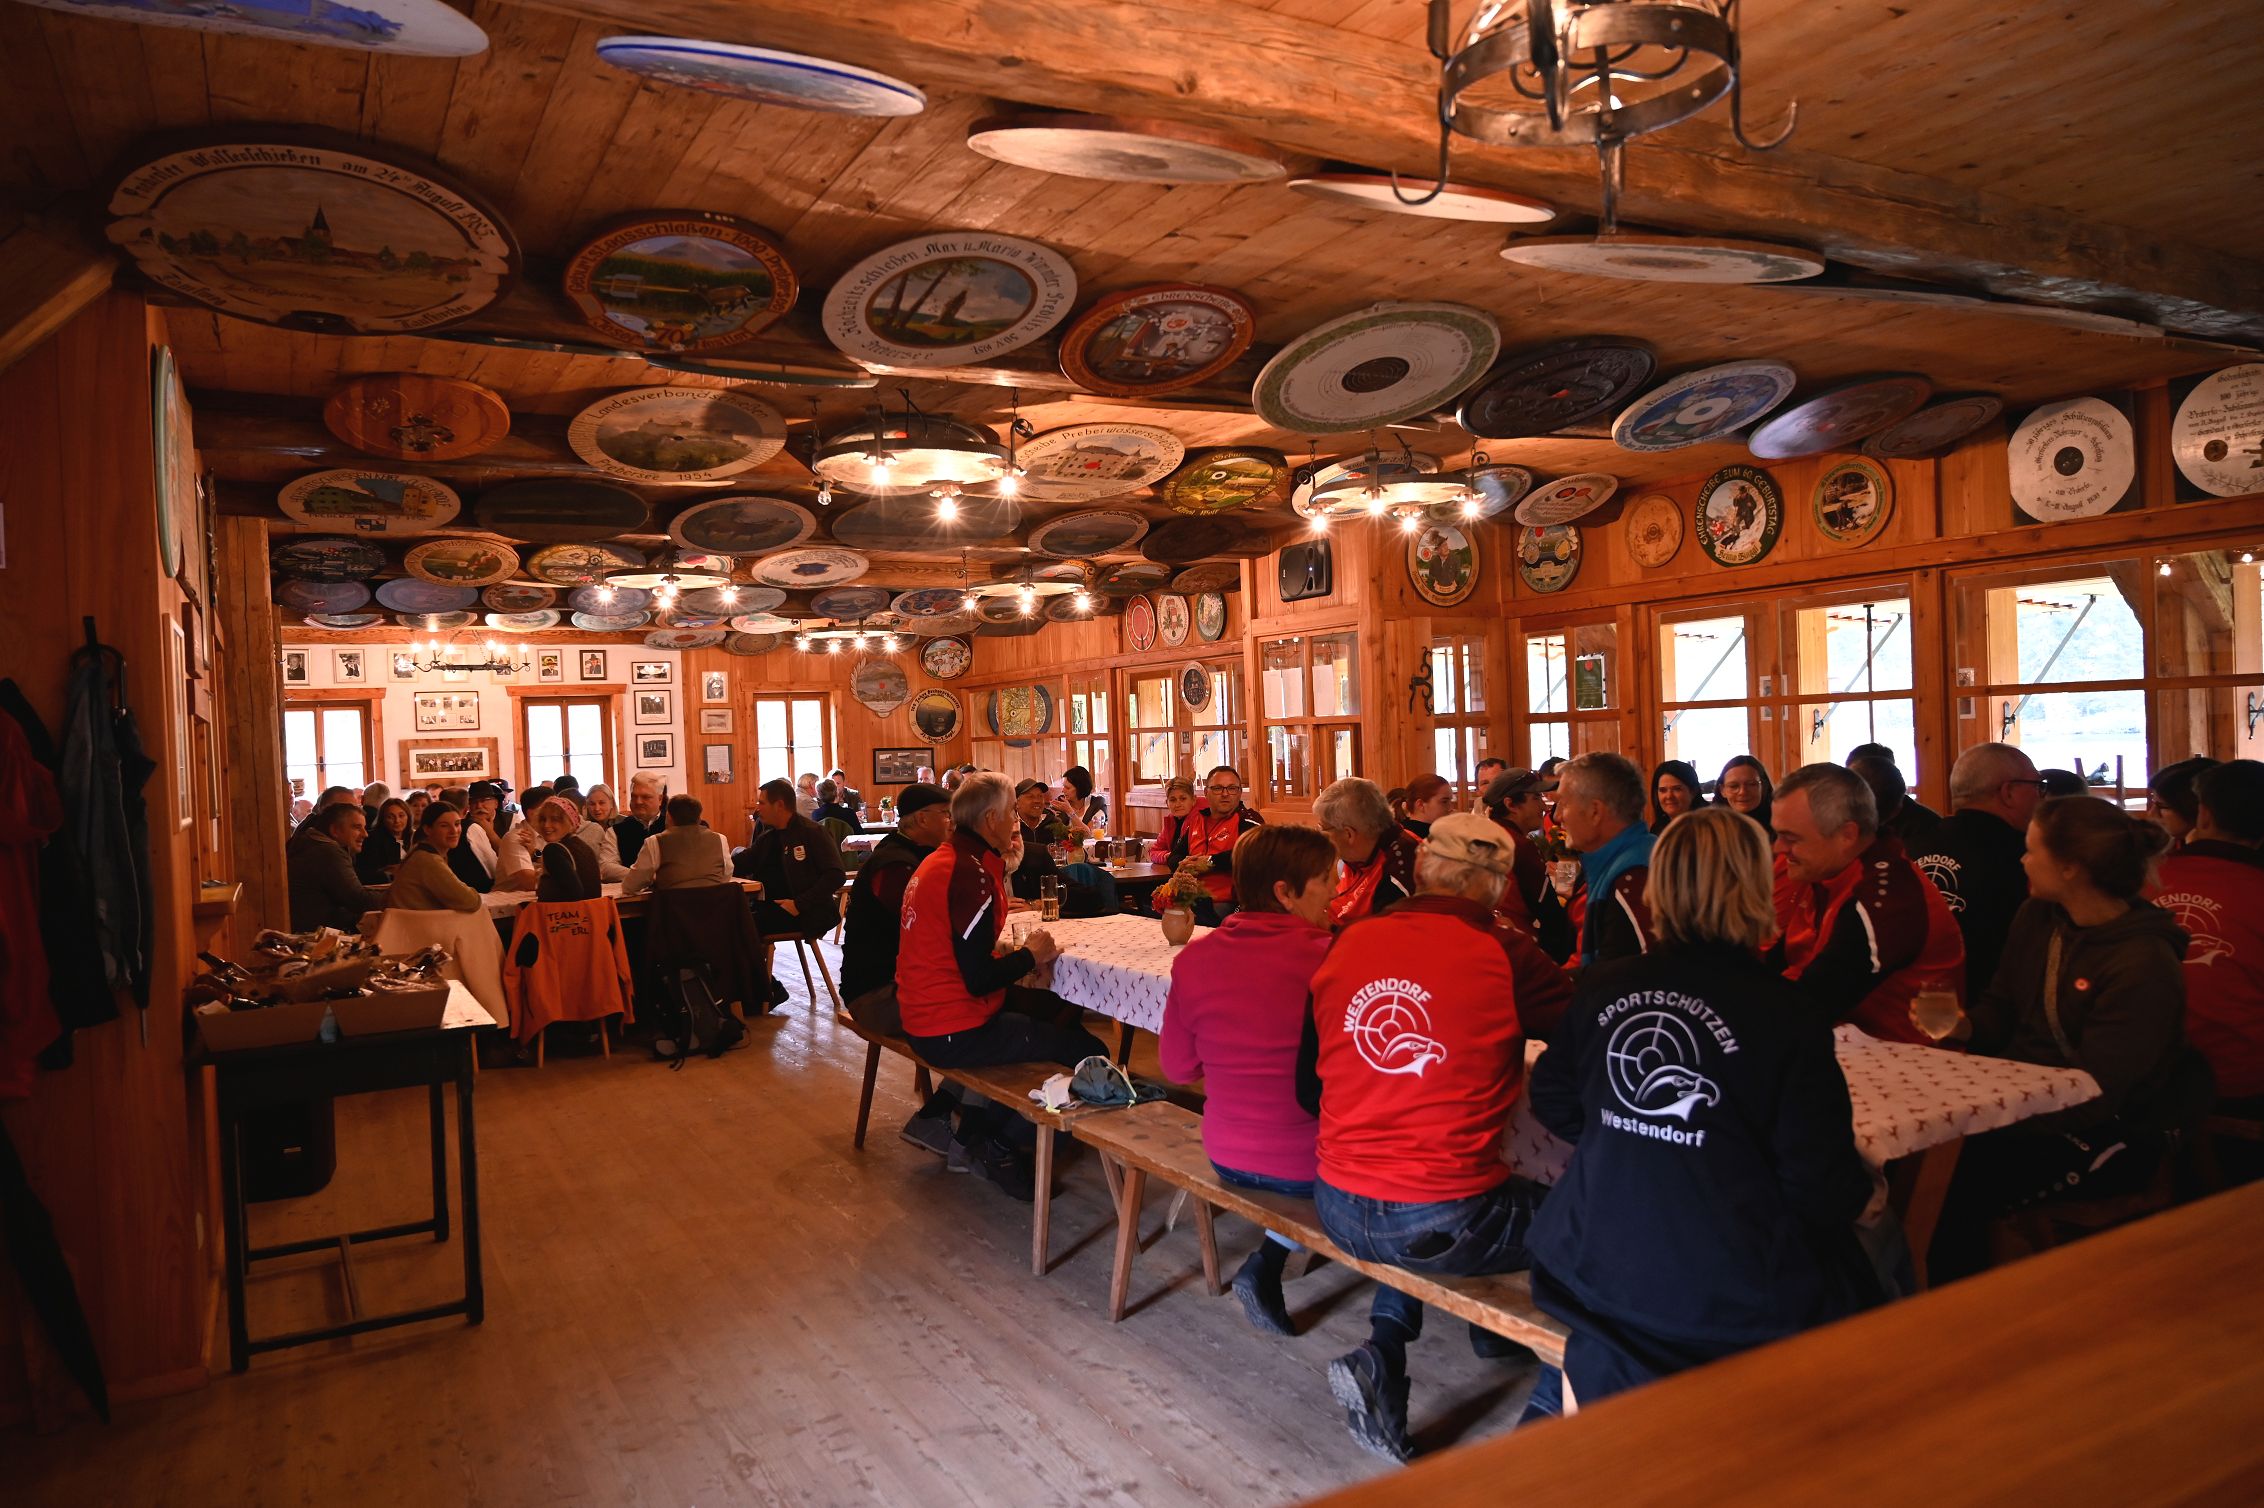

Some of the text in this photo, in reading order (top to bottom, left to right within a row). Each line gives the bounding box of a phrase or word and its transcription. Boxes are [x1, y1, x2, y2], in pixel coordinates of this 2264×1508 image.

[655, 328, 686, 344] 70
[1754, 475, 1778, 536] GEBURTSTAG
[547, 910, 580, 922] TEAM
[571, 926, 591, 936] ERL
[1343, 977, 1432, 1032] WESTENDORF
[1597, 989, 1740, 1055] SPORTSCHÜTZEN
[1600, 1107, 1707, 1148] Westendorf
